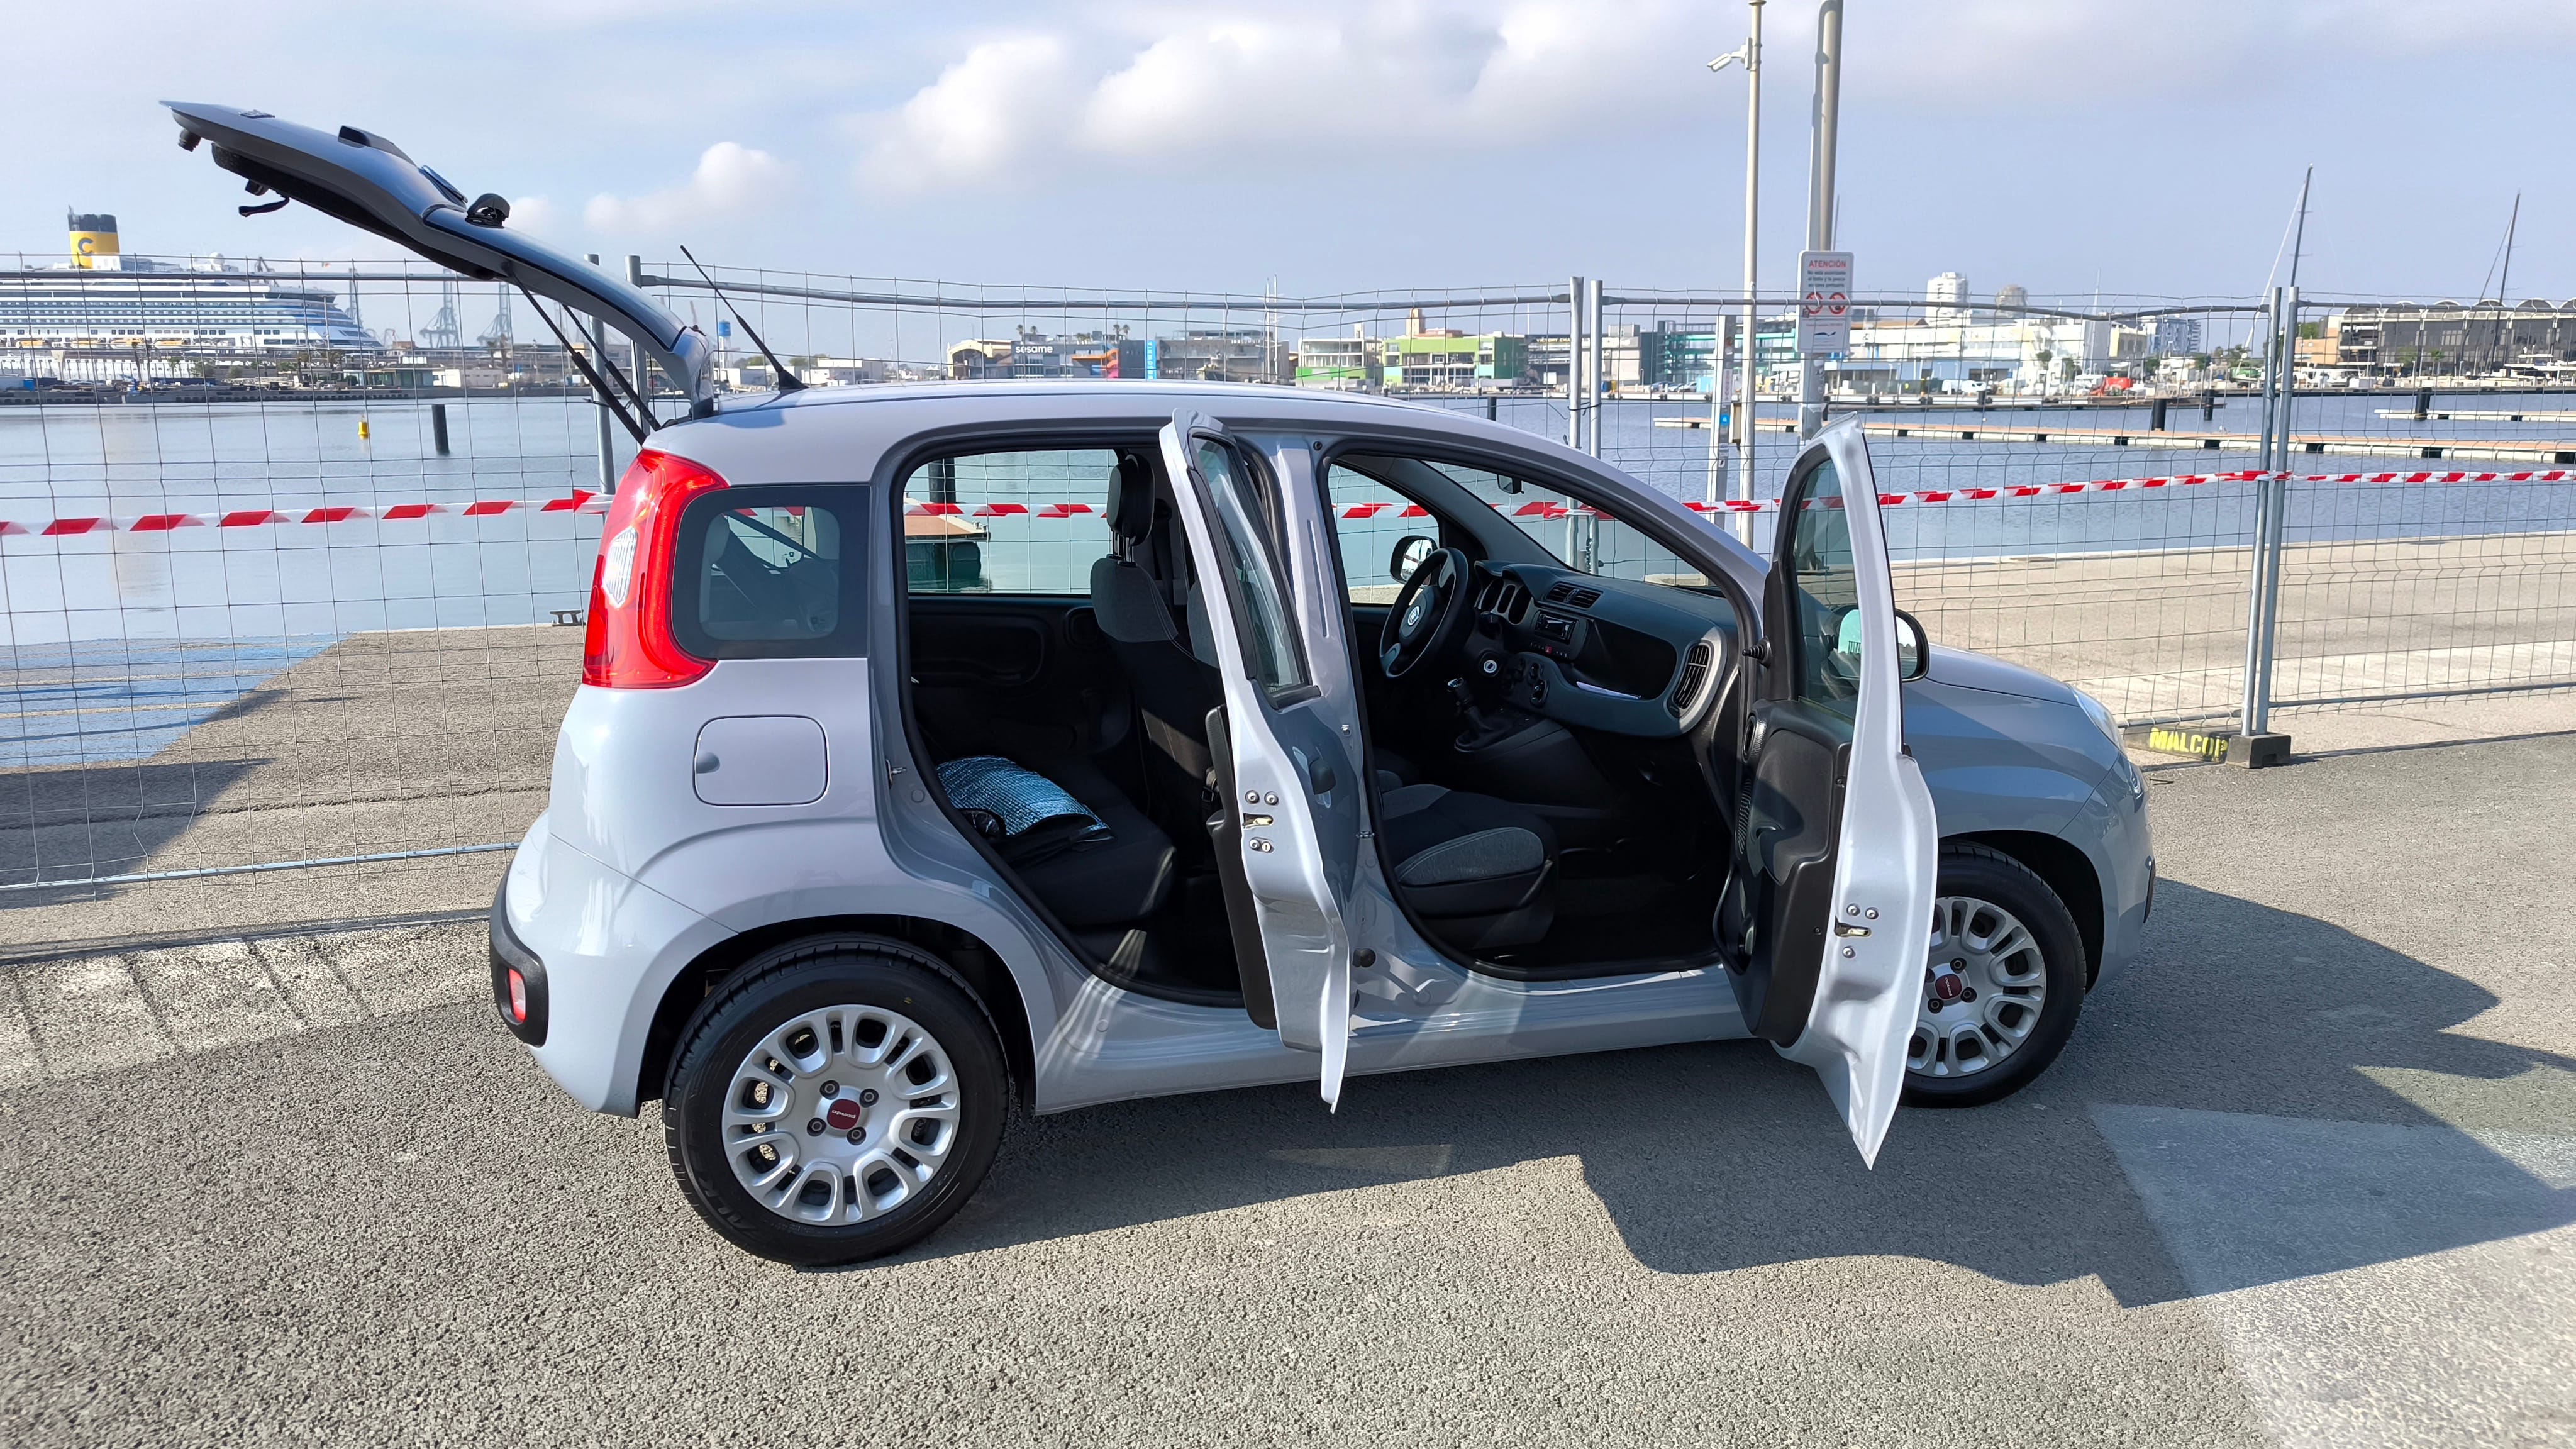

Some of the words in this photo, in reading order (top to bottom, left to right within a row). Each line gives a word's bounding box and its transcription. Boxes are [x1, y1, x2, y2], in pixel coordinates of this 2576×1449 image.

[1809, 258, 1846, 267] ATENCIÓN
[1015, 345, 1053, 353] sesame
[831, 1109, 857, 1119] panda
